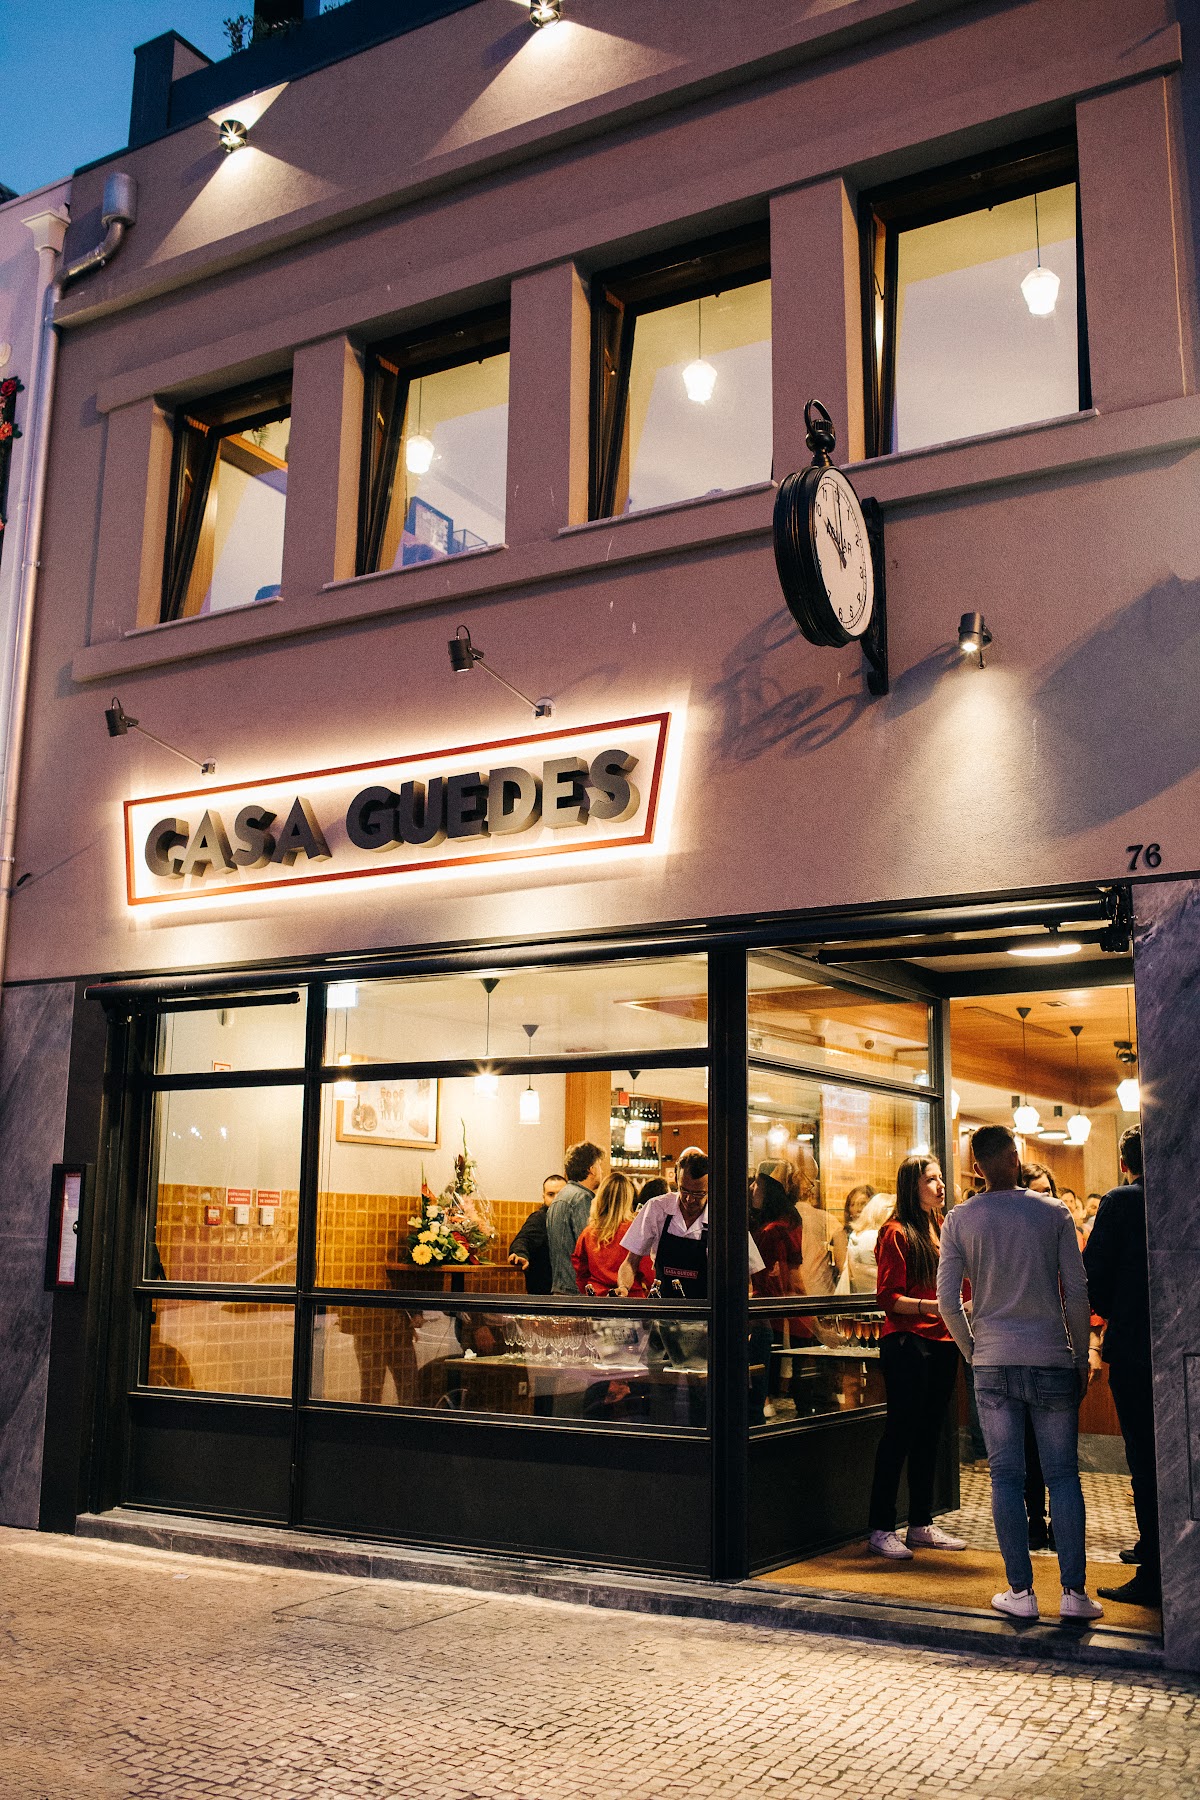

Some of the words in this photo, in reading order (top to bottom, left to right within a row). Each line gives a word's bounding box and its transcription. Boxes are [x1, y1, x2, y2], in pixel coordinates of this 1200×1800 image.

[821, 486, 828, 502] 11
[815, 501, 822, 517] 10
[855, 533, 860, 548] 2
[859, 565, 864, 580] 3
[856, 592, 861, 604] 4
[838, 606, 844, 621] 6
[849, 604, 854, 619] 5
[144, 795, 331, 878] CASA
[346, 748, 640, 852] GUEDES
[1126, 843, 1162, 870] 76
